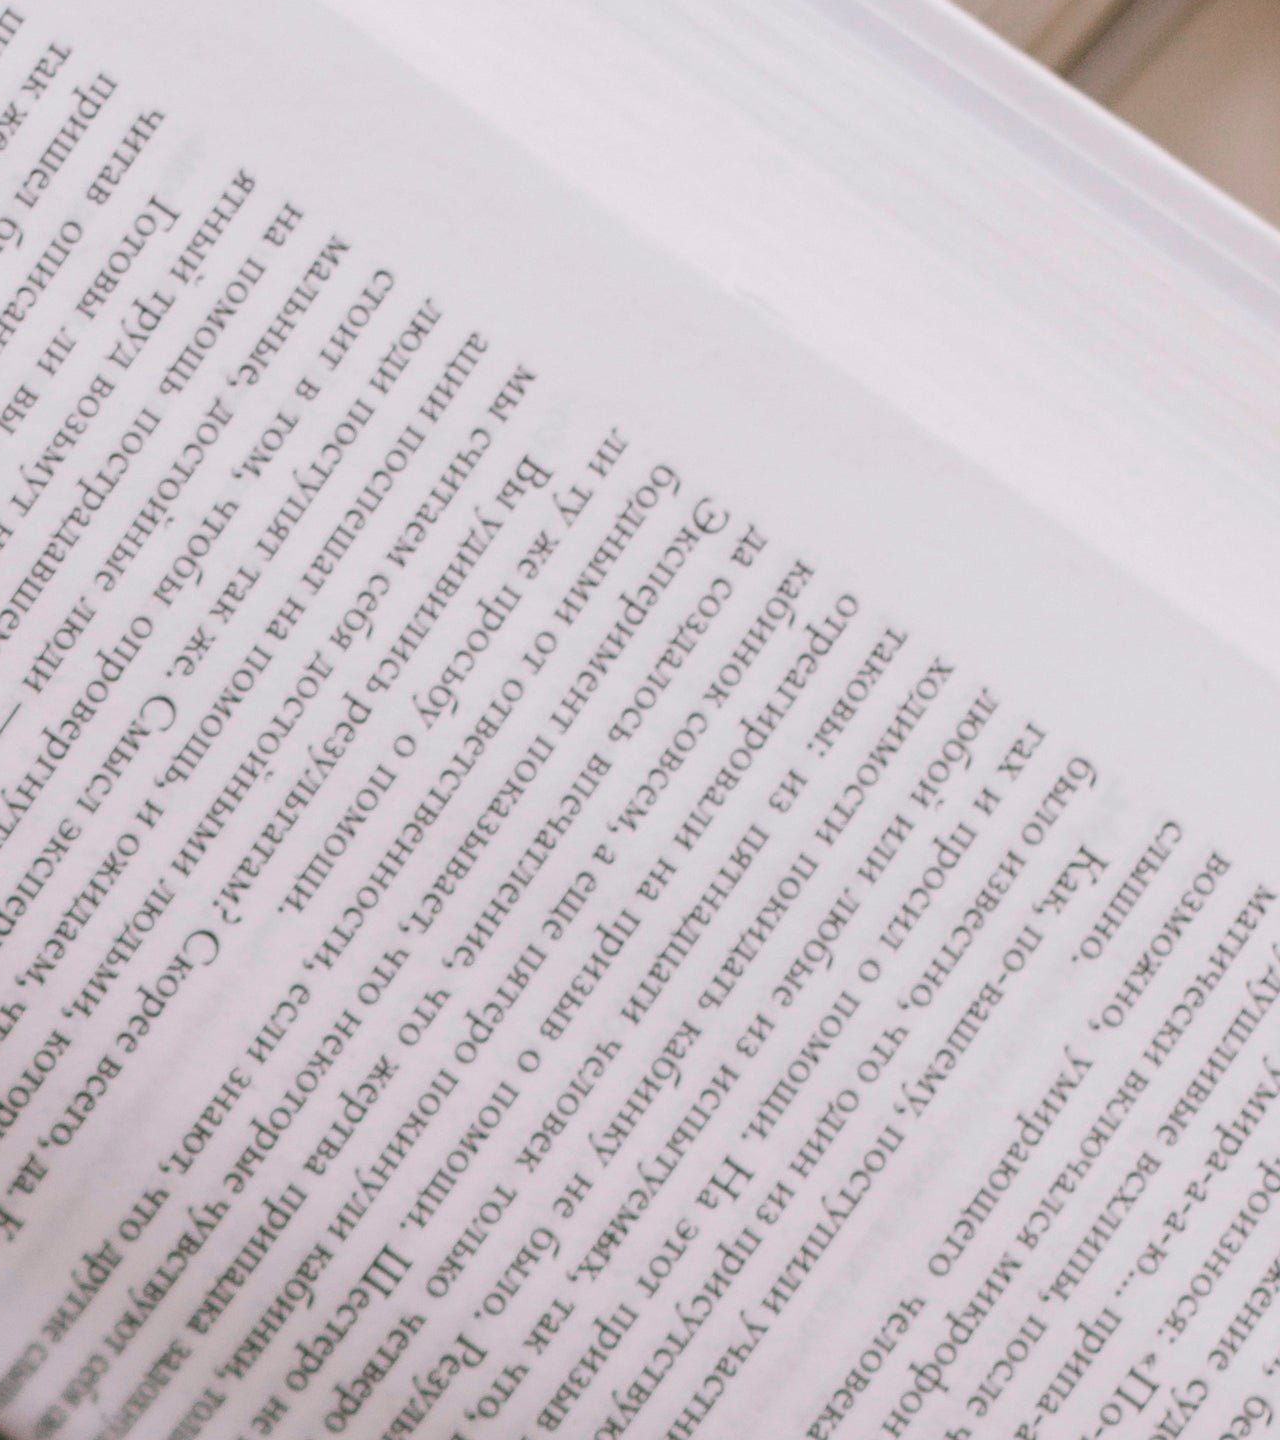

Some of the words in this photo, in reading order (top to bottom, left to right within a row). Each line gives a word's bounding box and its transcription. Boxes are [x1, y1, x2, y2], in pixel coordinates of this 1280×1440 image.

[168, 166, 257, 286] ятный
[103, 289, 178, 372] труд
[367, 296, 444, 396] люди
[8, 372, 117, 519] возьмут
[253, 397, 377, 564] поступят
[494, 452, 556, 513] Вы
[164, 624, 218, 679] же.
[207, 564, 263, 626] так
[364, 504, 505, 694] удивились
[701, 557, 816, 710] кабинок
[74, 692, 179, 816] Смысл
[210, 689, 374, 926] результатам?
[605, 709, 709, 834] совсем,
[540, 869, 598, 942] еще
[590, 842, 617, 867] а
[114, 927, 222, 1055] Скорее
[453, 941, 549, 1066] пятеро
